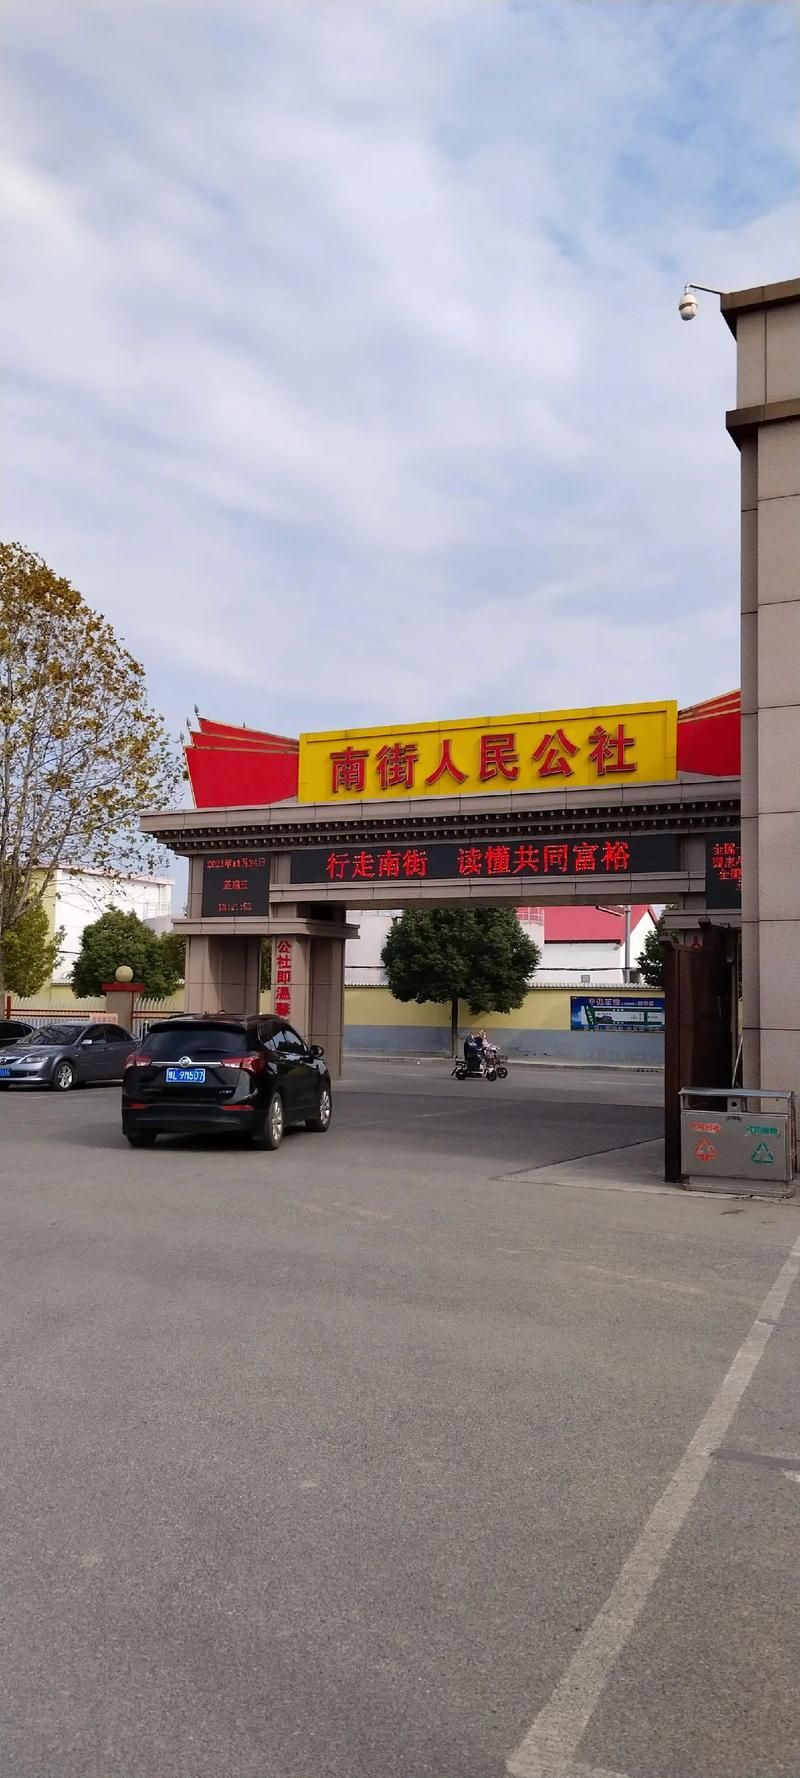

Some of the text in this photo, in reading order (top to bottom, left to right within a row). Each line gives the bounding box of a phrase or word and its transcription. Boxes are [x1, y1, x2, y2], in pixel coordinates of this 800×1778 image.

[329, 723, 637, 793] 南街人民公社
[326, 840, 630, 880] 行走南街 读懂共同富裕
